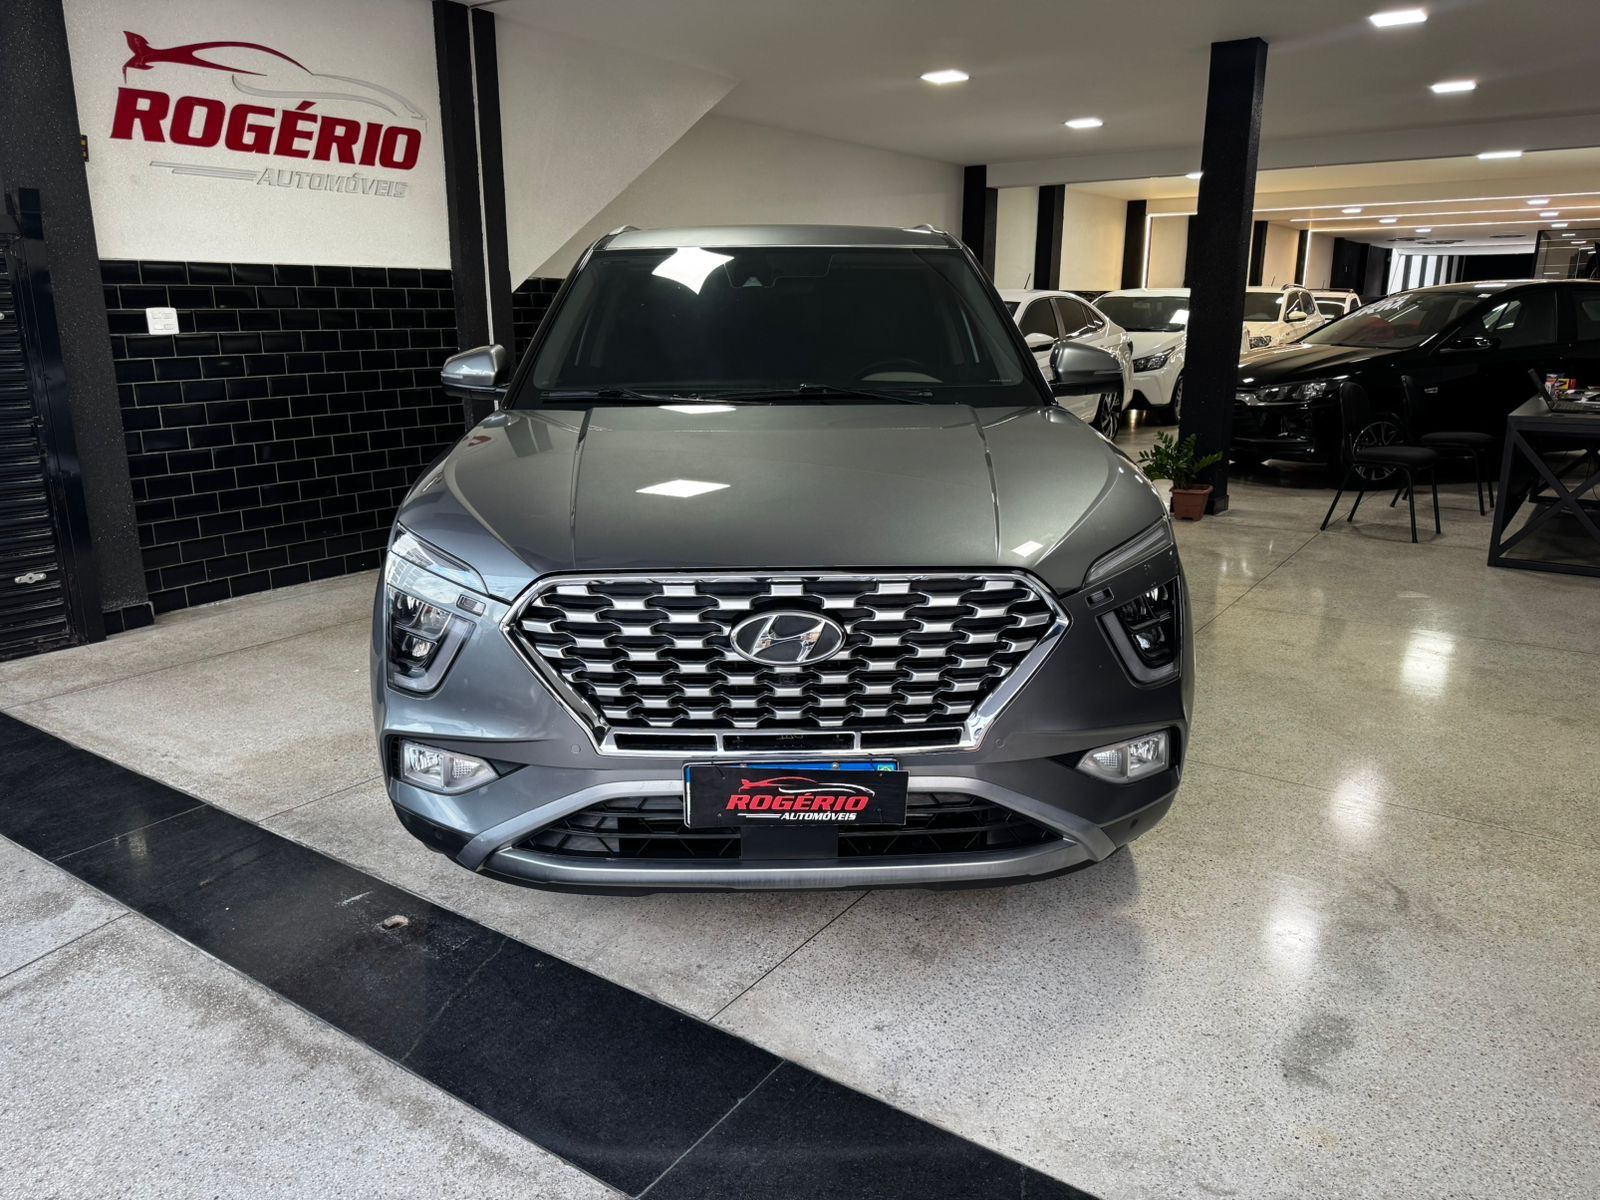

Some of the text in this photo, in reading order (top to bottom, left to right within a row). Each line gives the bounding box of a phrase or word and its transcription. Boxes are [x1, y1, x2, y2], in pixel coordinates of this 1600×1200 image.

[110, 87, 421, 170] ROGÉRIO
[257, 168, 408, 198] AUTOMÓVEIS
[726, 794, 869, 811] ROGÉRIO
[781, 811, 857, 821] AUTOMÓVEIS
